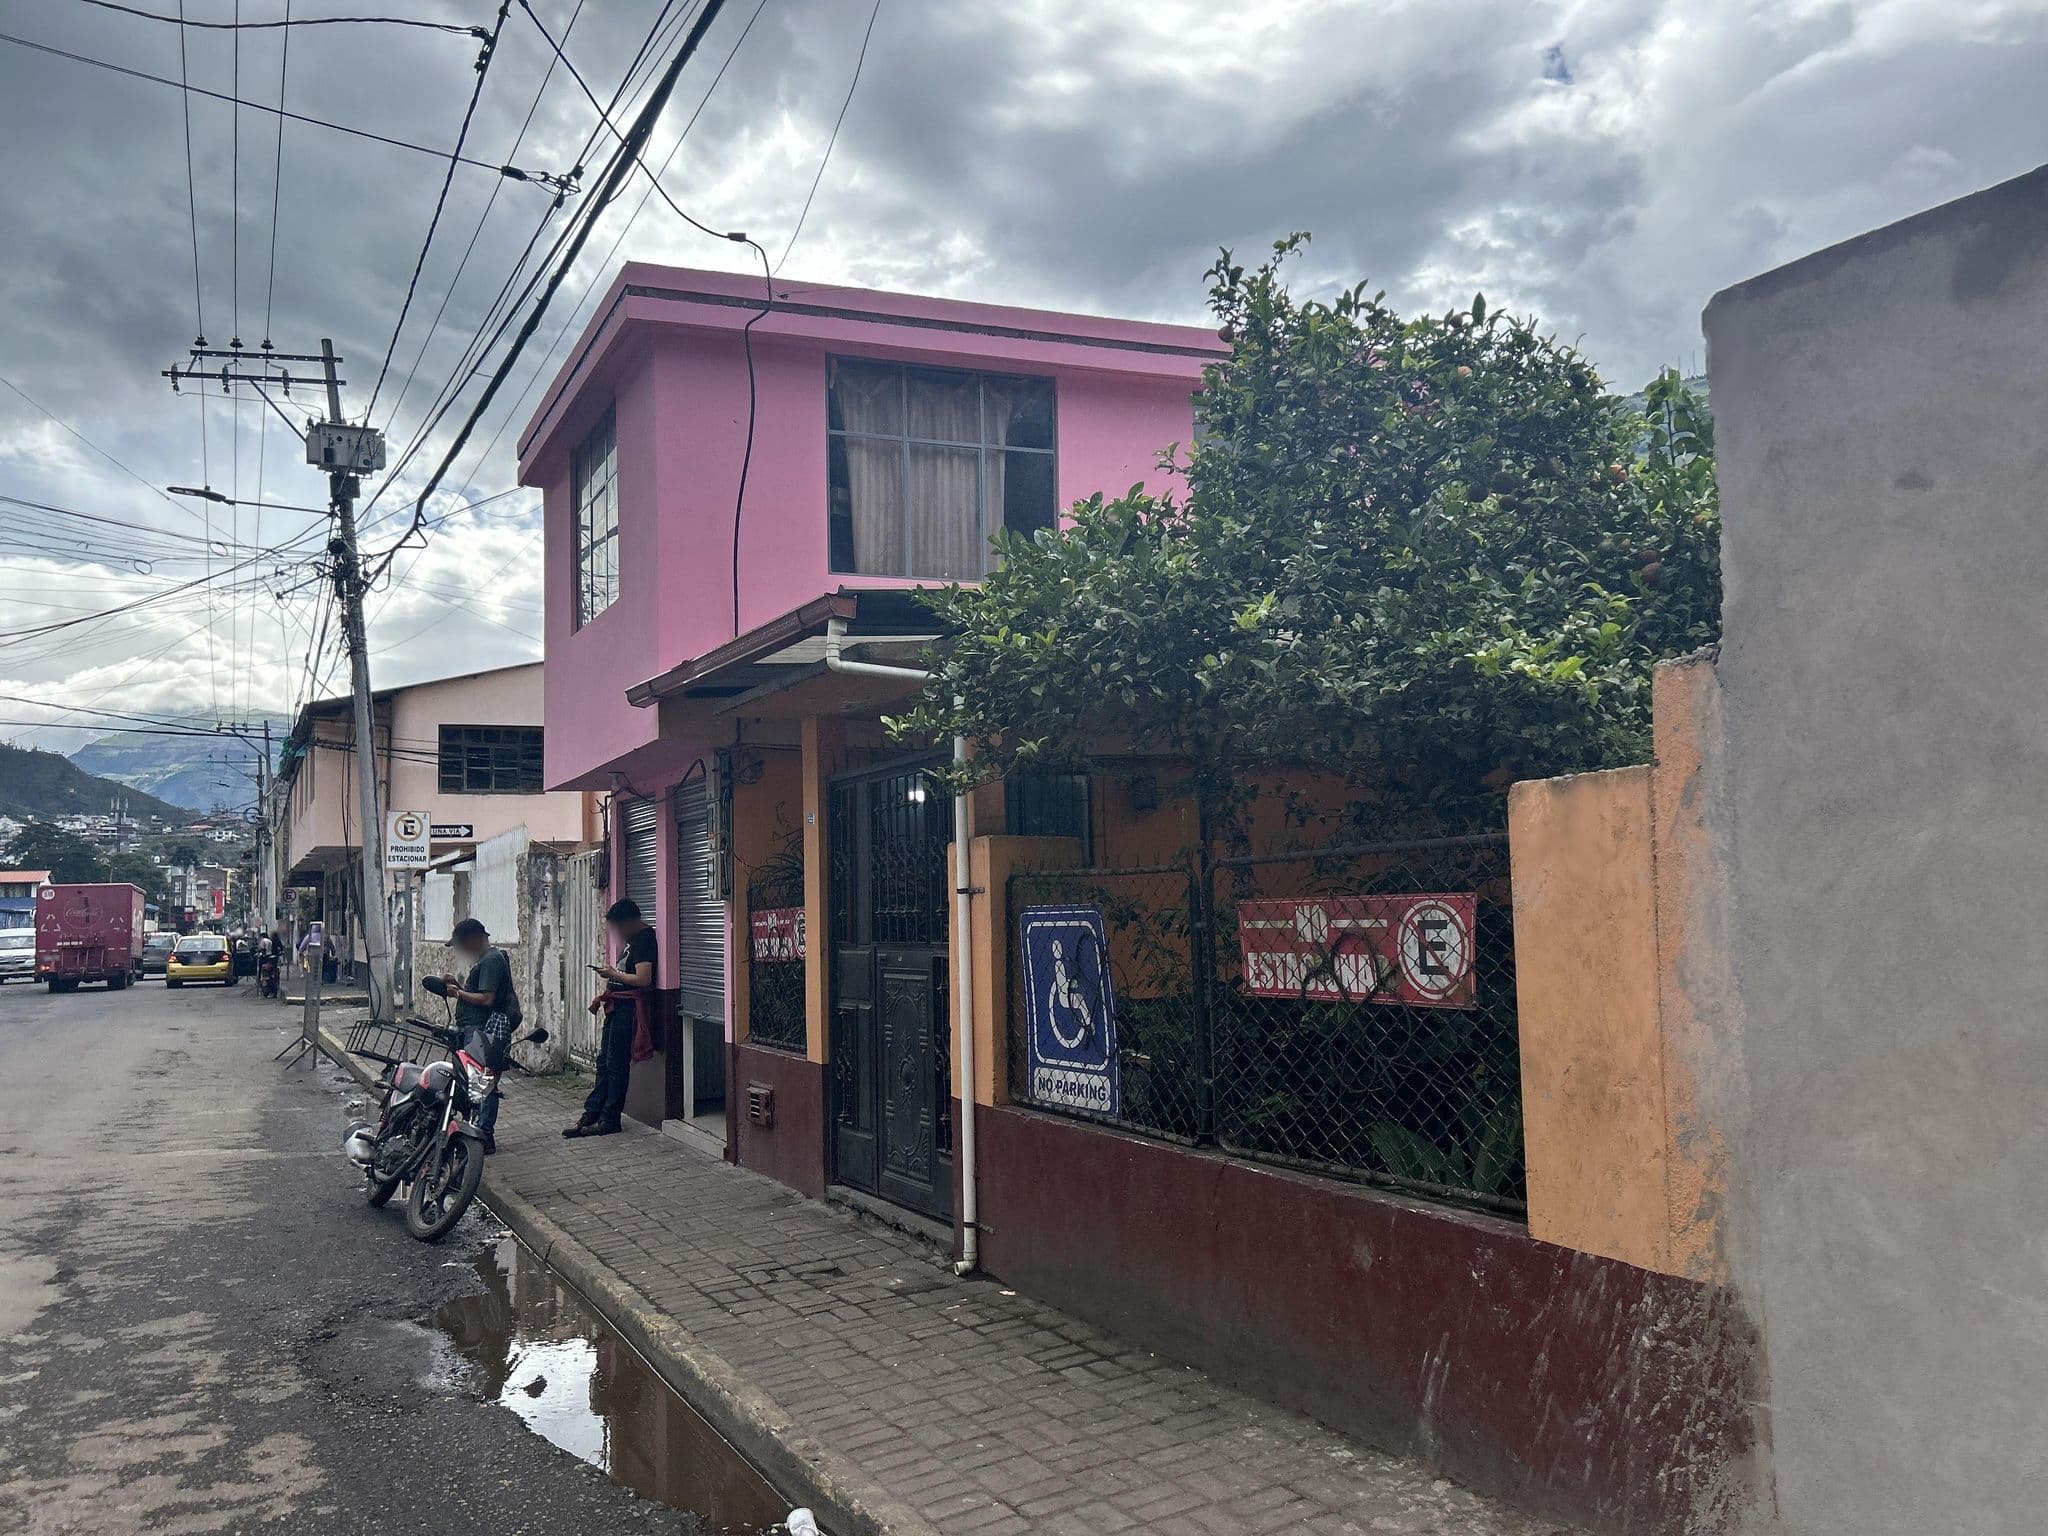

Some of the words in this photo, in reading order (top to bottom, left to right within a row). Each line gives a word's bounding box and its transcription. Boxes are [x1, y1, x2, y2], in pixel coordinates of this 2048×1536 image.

[404, 820, 415, 835] E
[1295, 904, 1329, 943] NO
[1417, 919, 1450, 976] E
[1038, 1077, 1053, 1091] NO
[1055, 1079, 1106, 1101] PARKING
